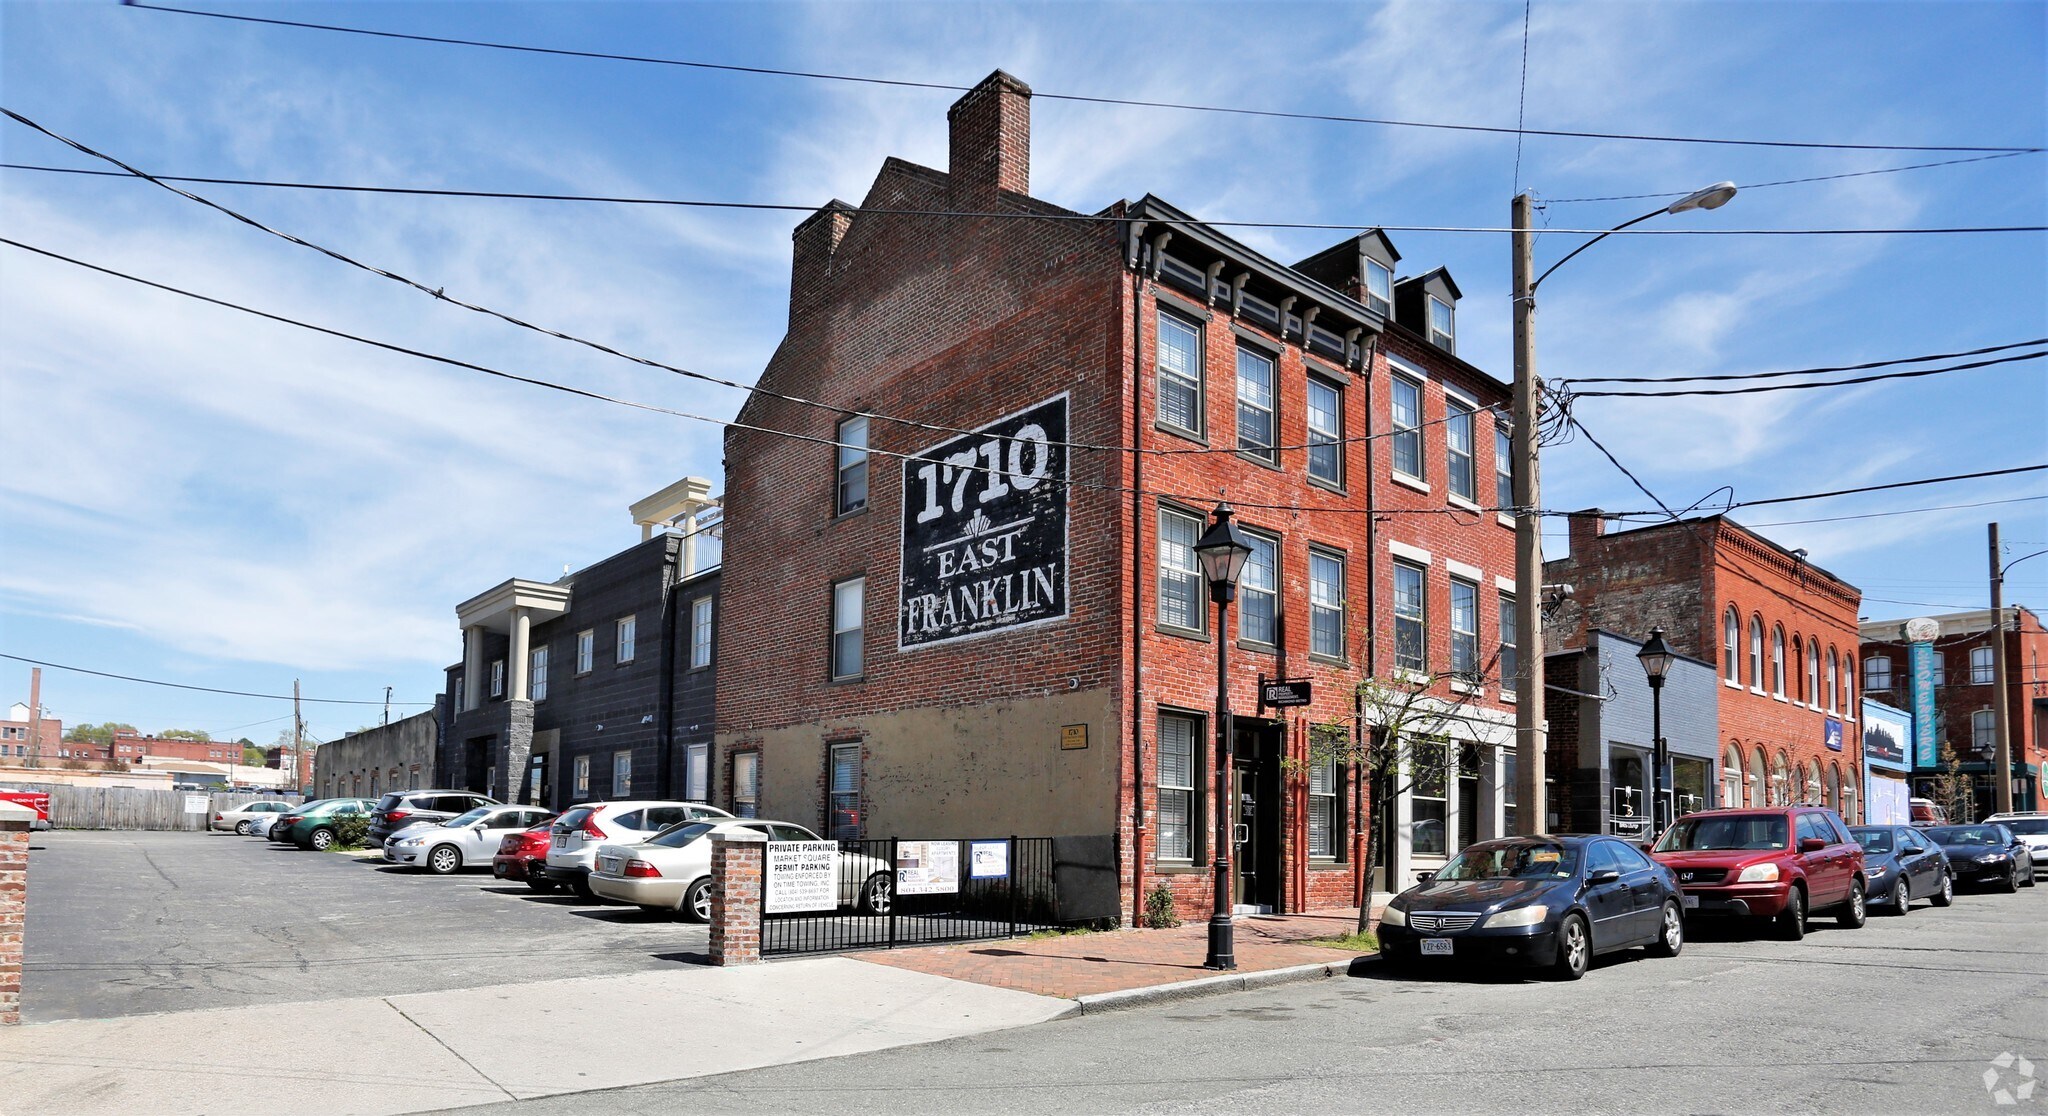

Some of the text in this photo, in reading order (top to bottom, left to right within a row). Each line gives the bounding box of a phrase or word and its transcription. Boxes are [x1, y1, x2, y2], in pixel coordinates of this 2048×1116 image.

[917, 423, 1049, 523] 1710
[937, 530, 1021, 580] EAST
[906, 562, 1056, 635] FRANKLIN
[769, 843, 836, 852] PRIVATE PARKING
[774, 854, 801, 862] MARKET
[774, 863, 830, 872] PERMIT PARKING
[795, 872, 823, 880] ENFORCED
[774, 881, 782, 889] ON
[804, 894, 830, 902] INFORMATION
[769, 903, 795, 911] CONCERNING
